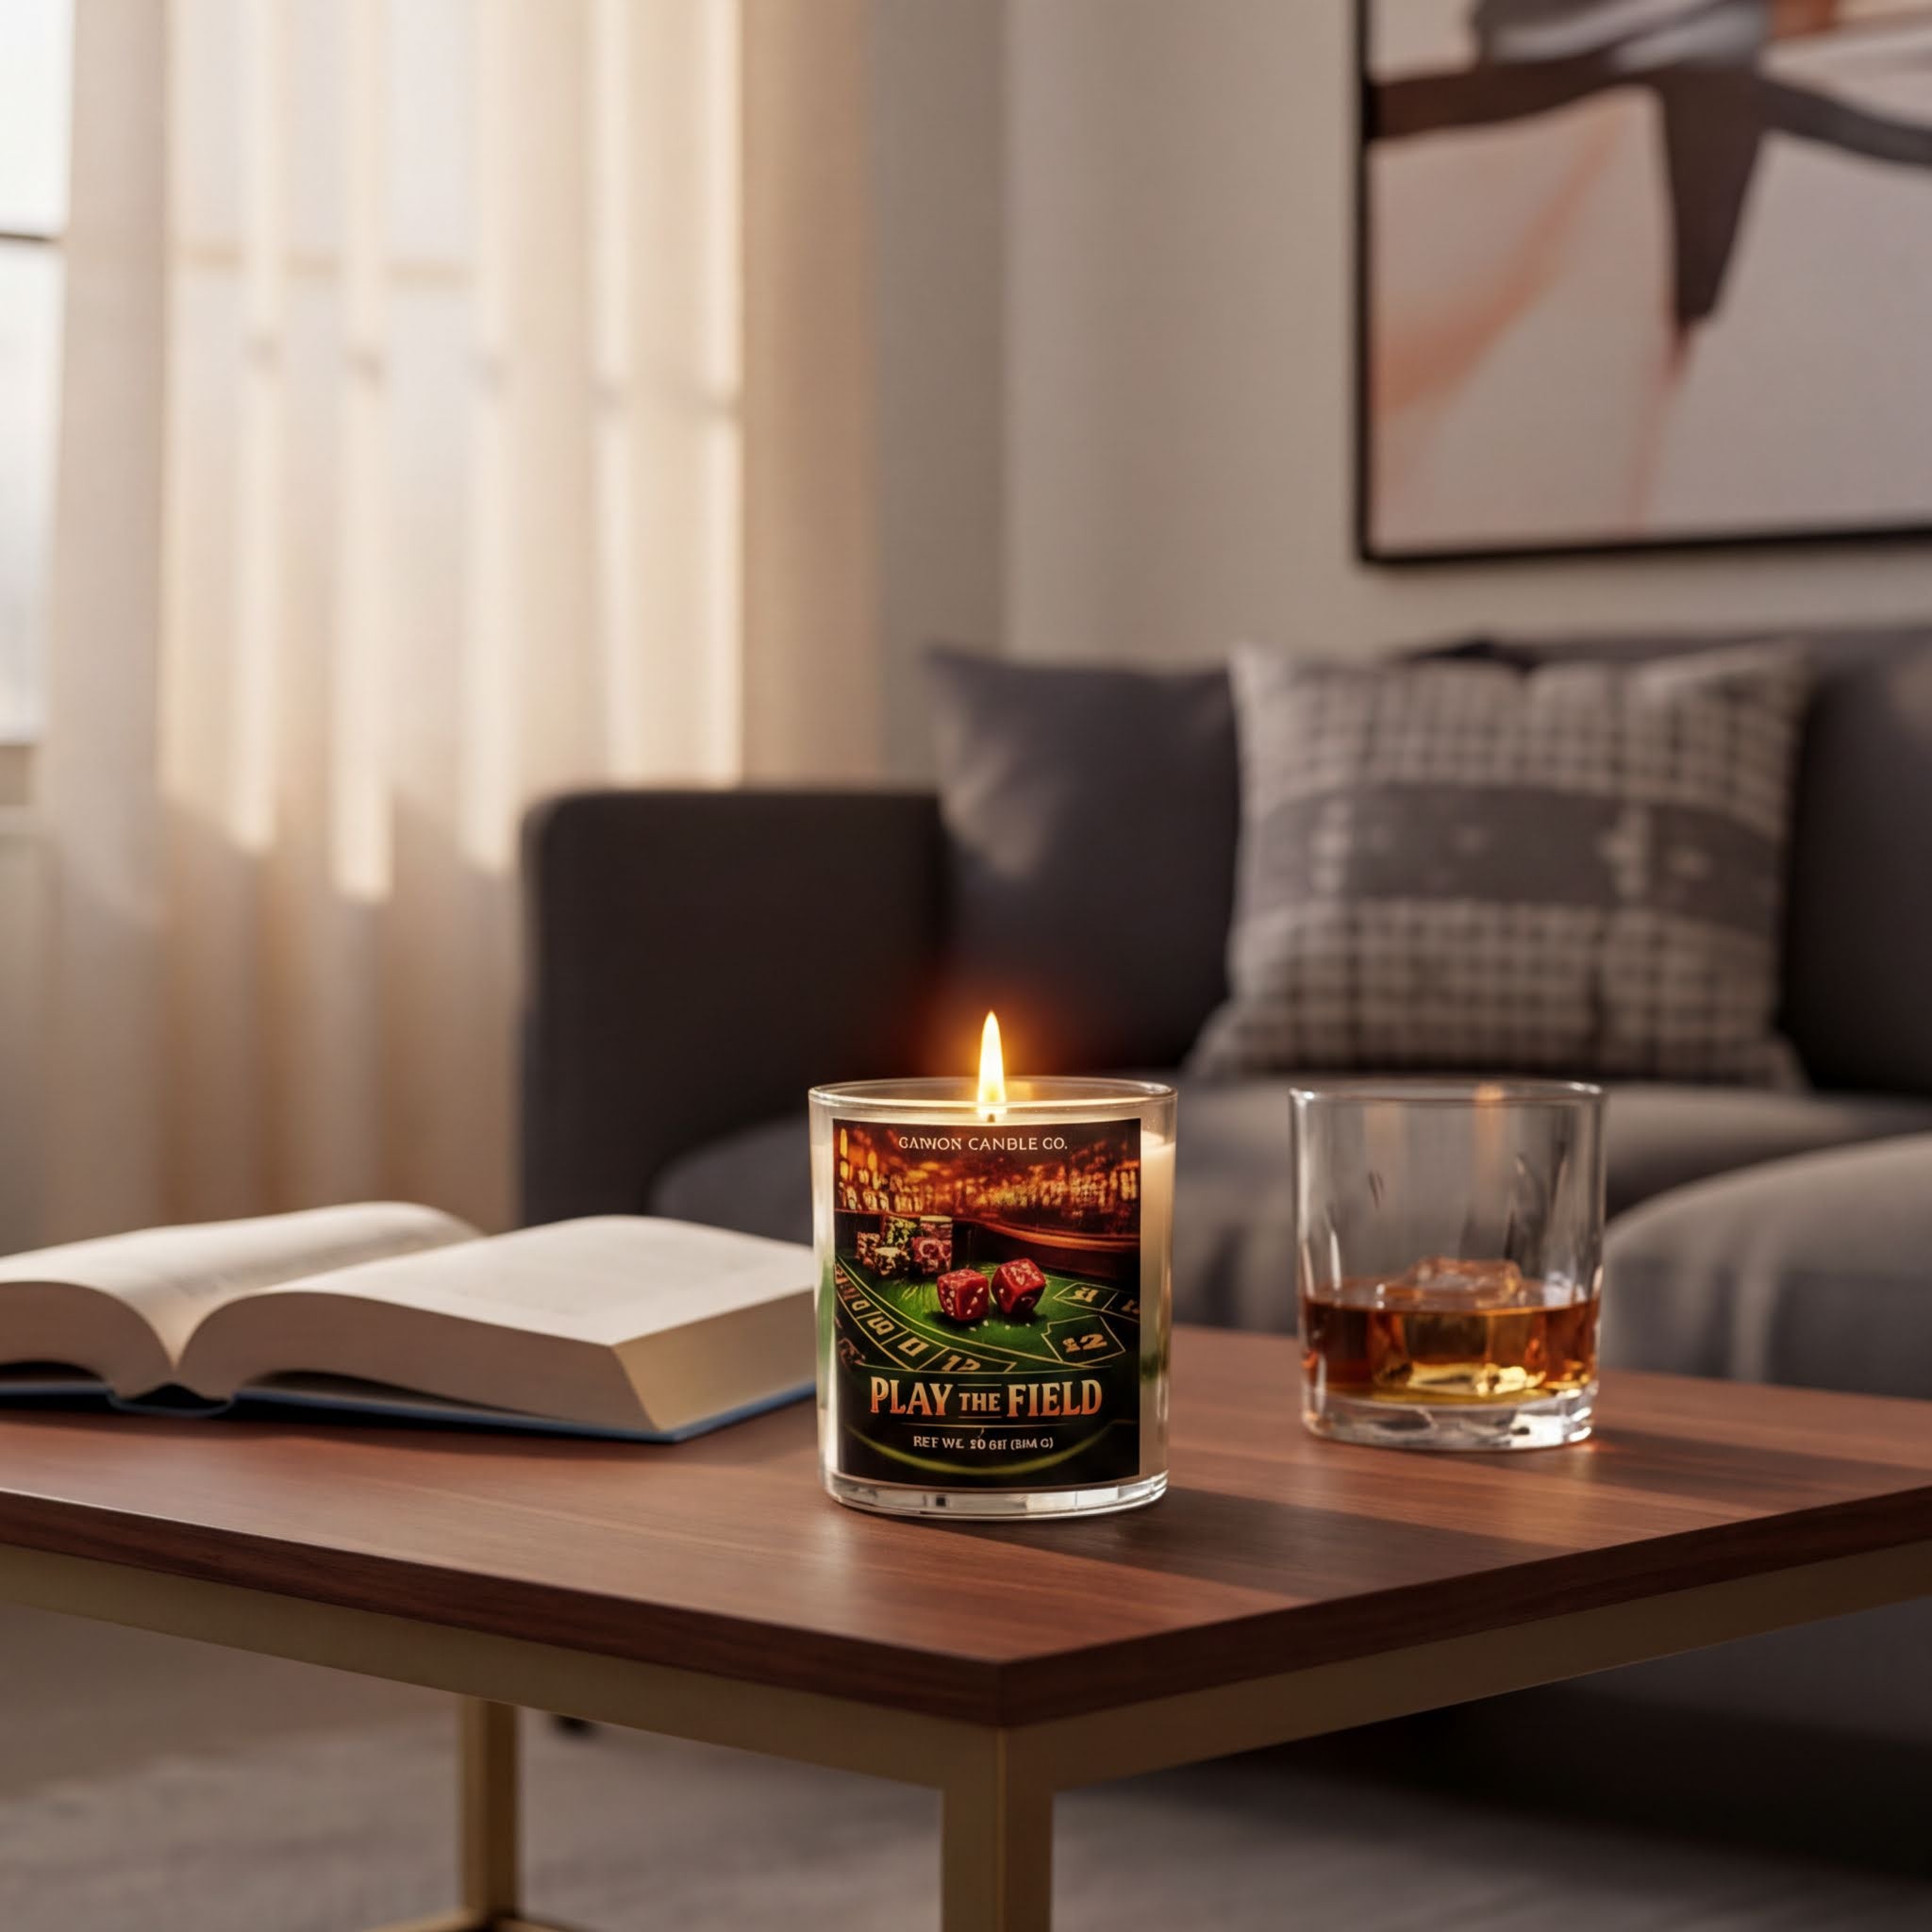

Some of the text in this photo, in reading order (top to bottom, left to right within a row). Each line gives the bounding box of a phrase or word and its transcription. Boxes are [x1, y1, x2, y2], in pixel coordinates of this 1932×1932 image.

[870, 1375, 1103, 1418] PLAY THE FIELD
